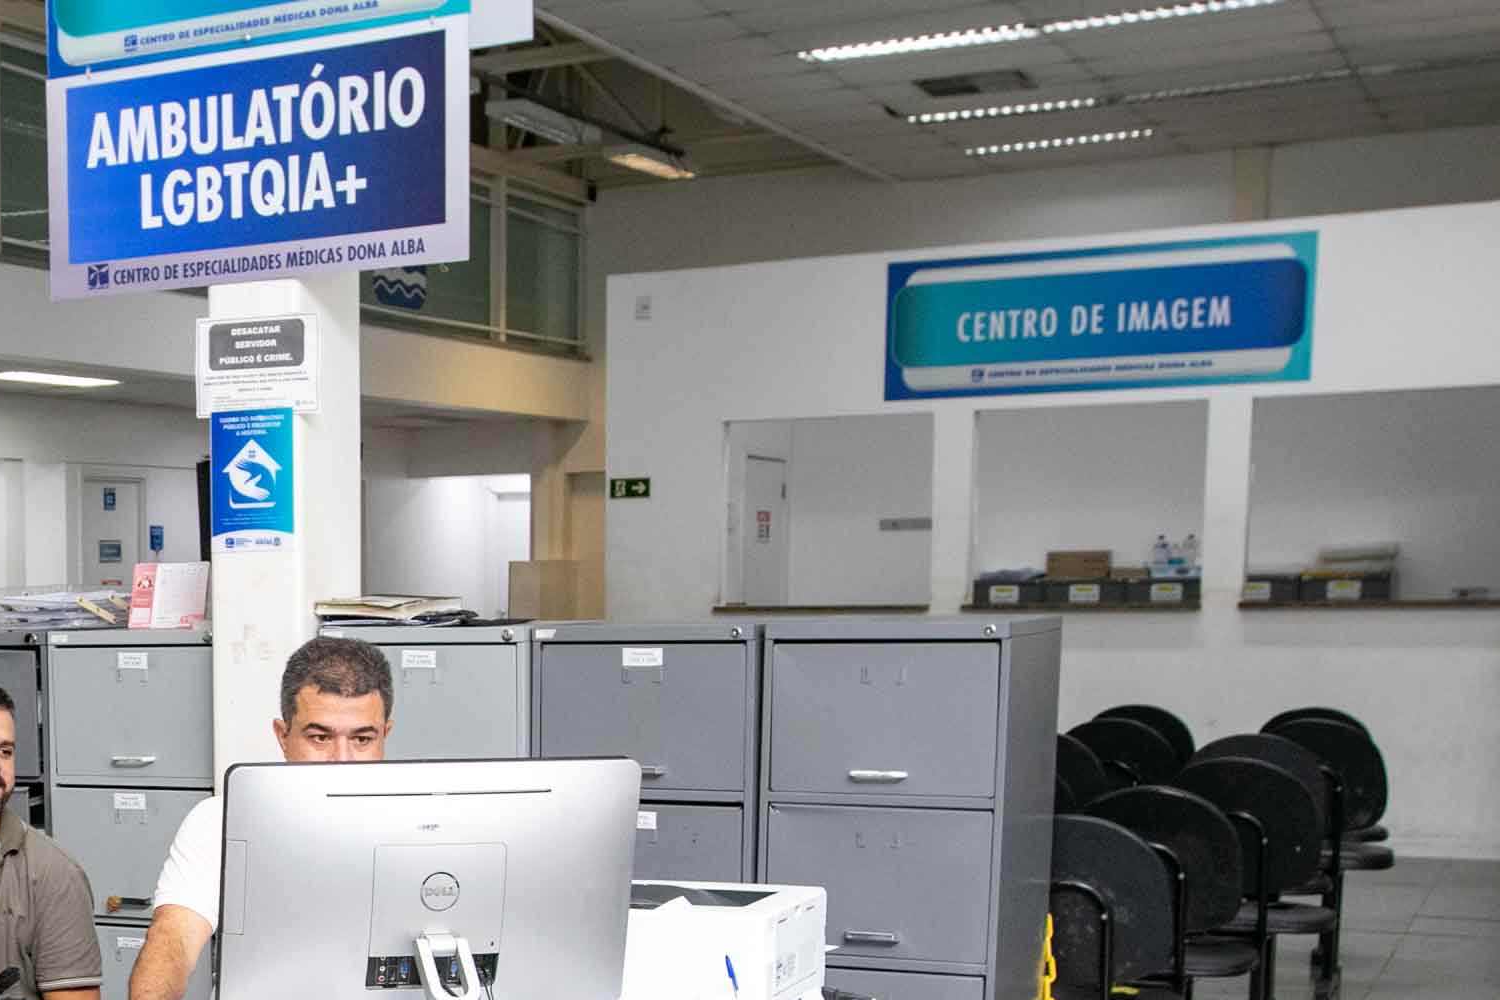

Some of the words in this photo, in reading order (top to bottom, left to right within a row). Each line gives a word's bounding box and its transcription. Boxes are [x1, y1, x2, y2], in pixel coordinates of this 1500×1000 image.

[140, 33, 175, 45] CENTRO
[179, 30, 190, 39] DE
[320, 5, 350, 16] DONA
[353, 0, 379, 11] ALBA
[86, 63, 426, 169] AMBULATÓRIO
[140, 151, 368, 231] LGBTQIA+
[113, 265, 160, 286] CENTRO
[164, 263, 180, 280] DE
[183, 253, 282, 278] ESPECIALIDADES
[285, 246, 343, 268] MÉDICAS
[347, 241, 386, 262] DONA
[390, 237, 426, 257] ALBA
[231, 325, 281, 336] DESACATAR
[956, 307, 1058, 343] CENTRO
[1071, 304, 1105, 336] DE
[1117, 295, 1232, 333] IMAGEM
[235, 339, 277, 349] SERVIDOR
